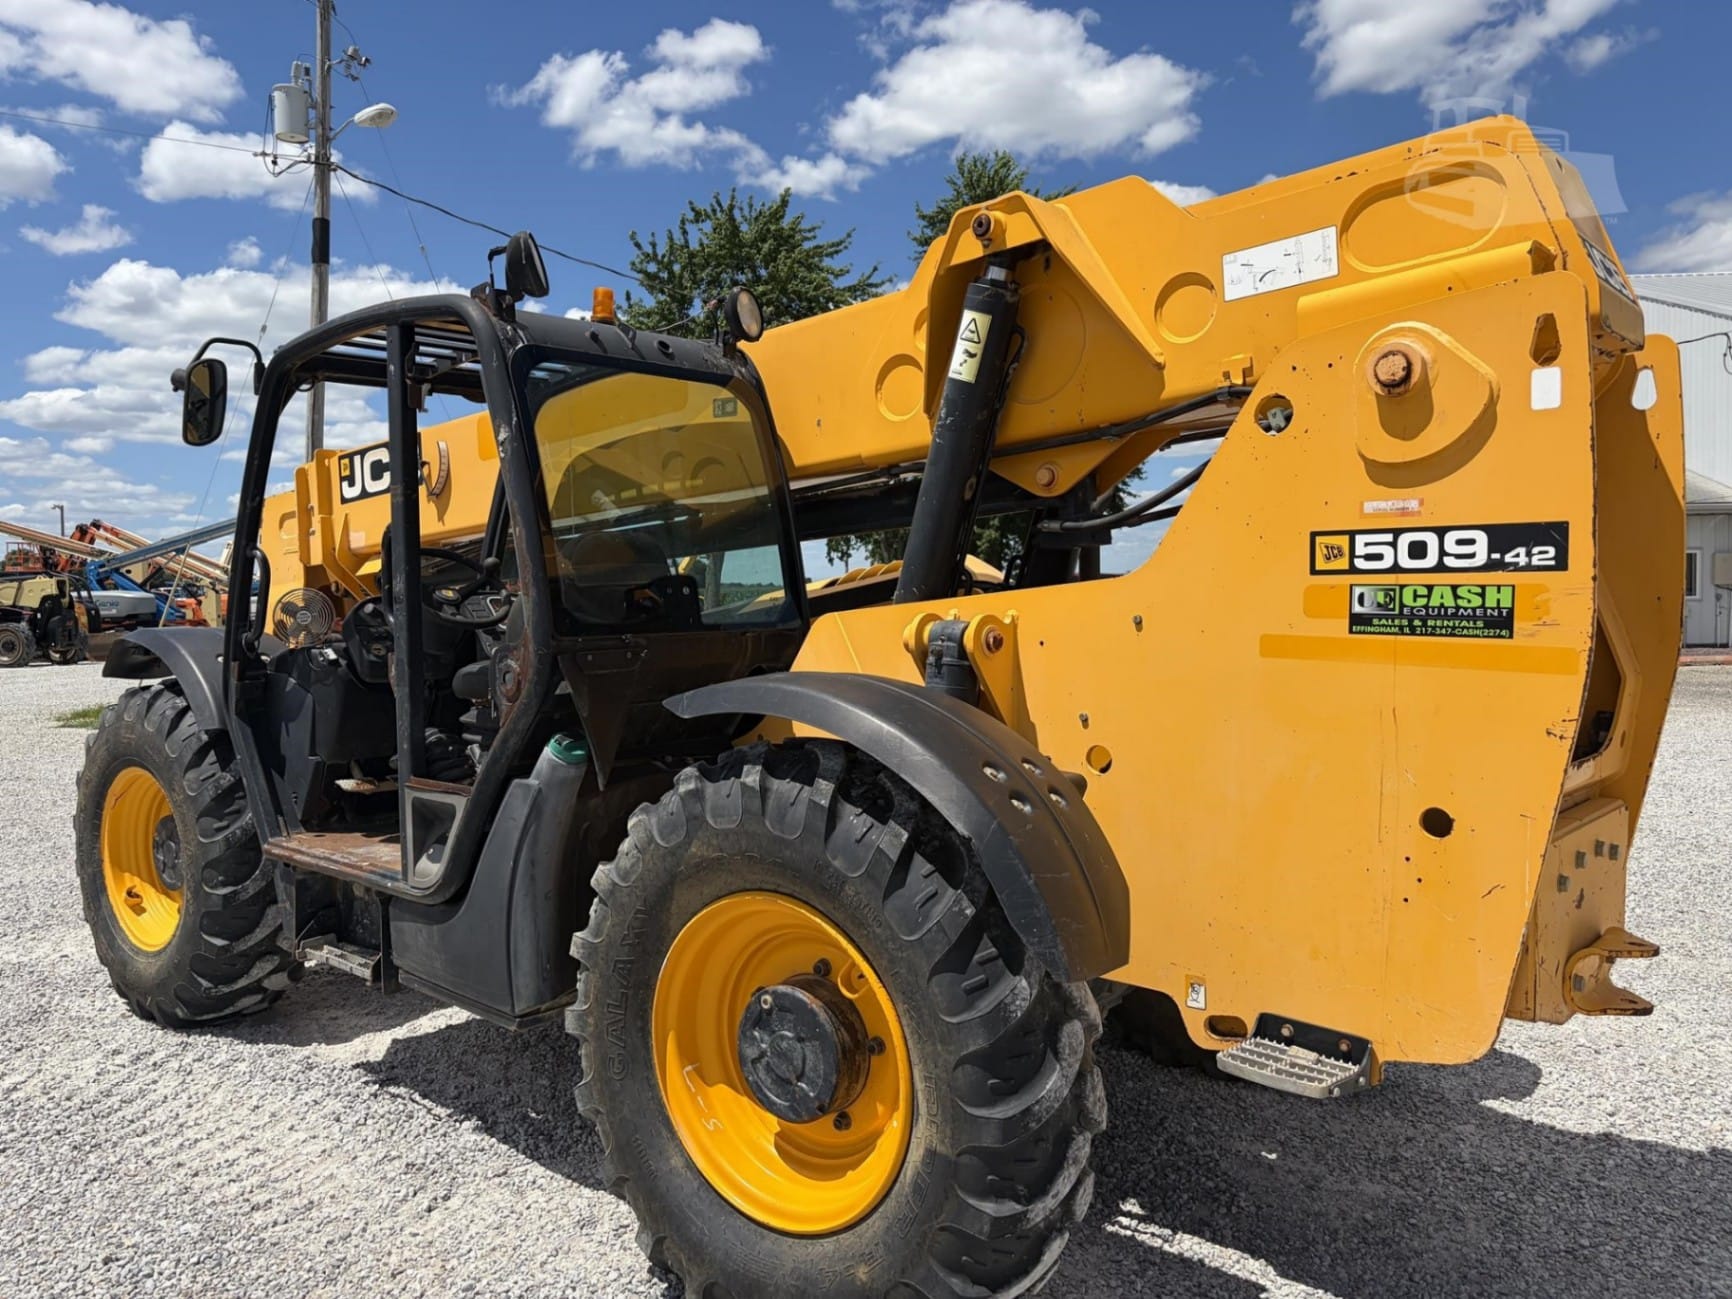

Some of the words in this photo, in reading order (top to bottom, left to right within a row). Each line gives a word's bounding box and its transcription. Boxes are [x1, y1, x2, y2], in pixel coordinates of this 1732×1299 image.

[341, 447, 391, 499] JC
[1322, 543, 1346, 562] JCB
[1353, 529, 1556, 570] 509-42
[1402, 585, 1513, 608] CASH
[1402, 606, 1511, 617] EQUIPMENT
[1352, 625, 1403, 635] EFFINGHAM,
[1403, 626, 1412, 635] IL
[1415, 626, 1510, 638] 217-347-CASH(2274)
[1372, 618, 1409, 627] SALES
[1413, 618, 1422, 627] &
[1427, 619, 1485, 628] RENTALS
